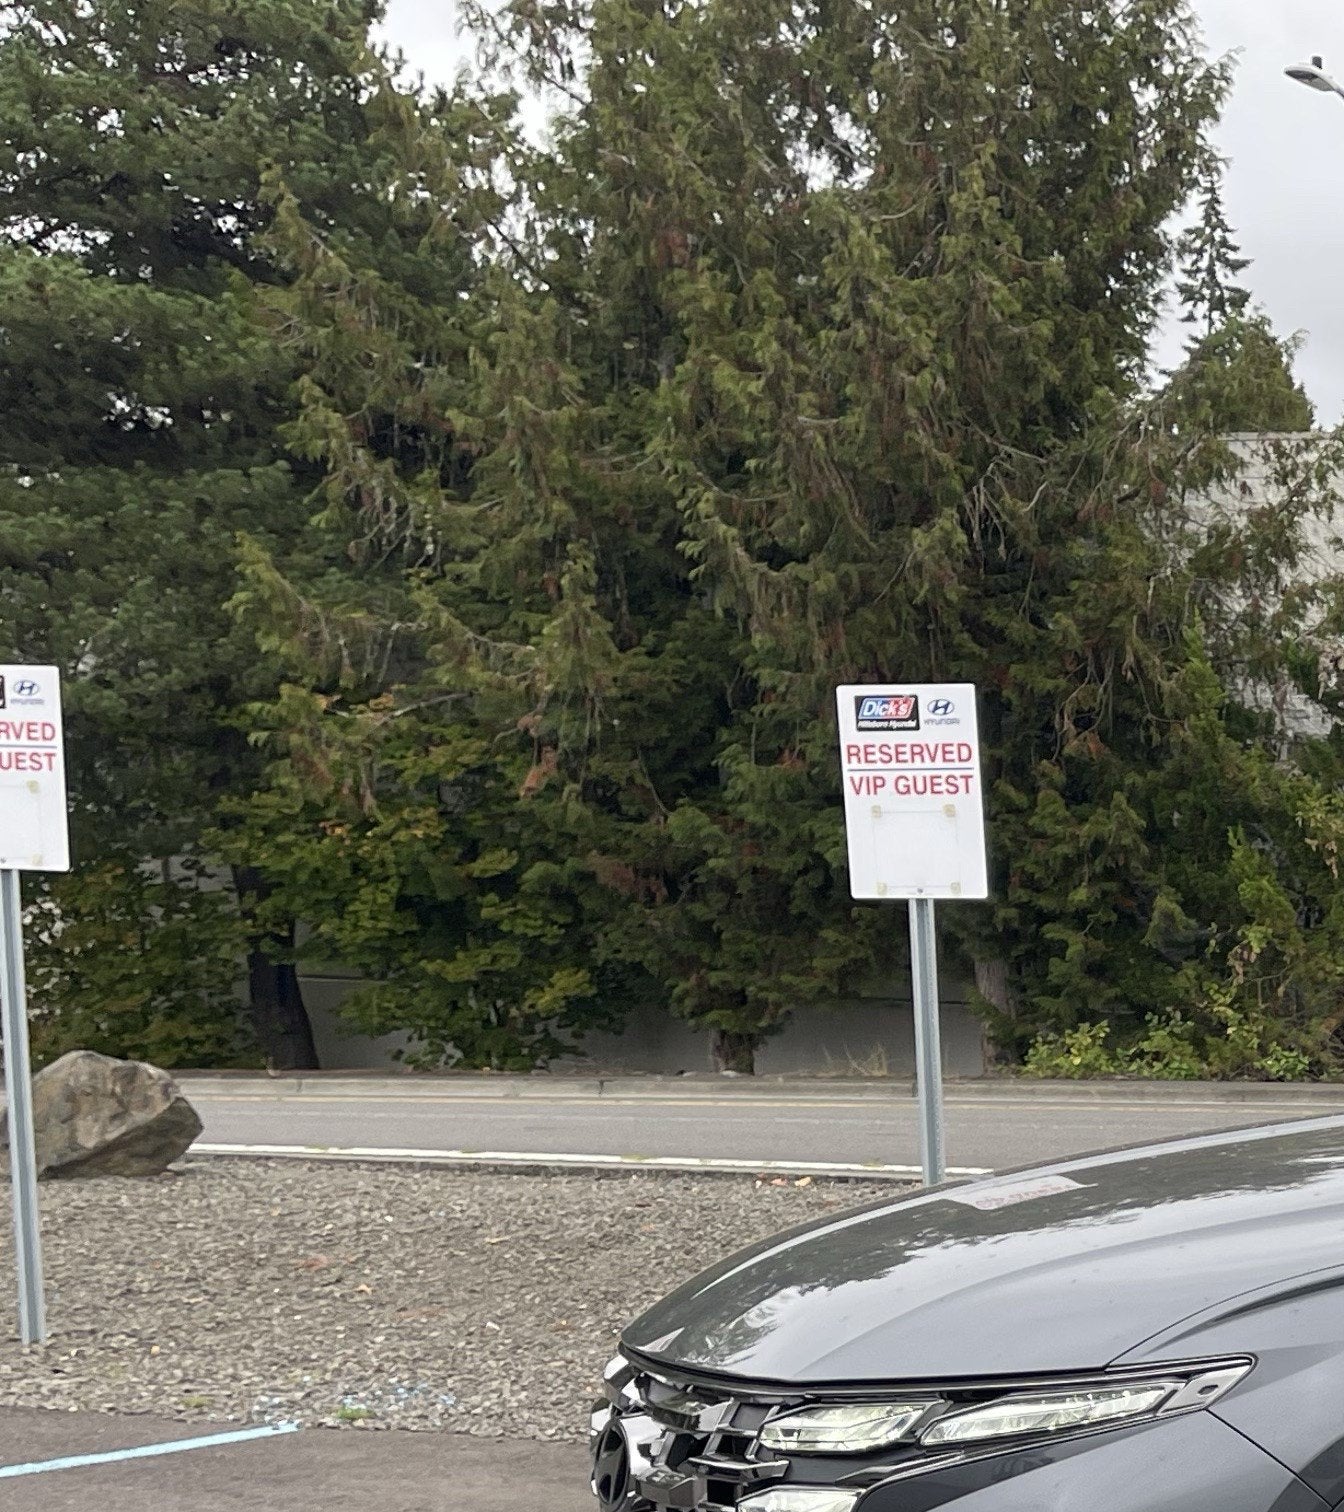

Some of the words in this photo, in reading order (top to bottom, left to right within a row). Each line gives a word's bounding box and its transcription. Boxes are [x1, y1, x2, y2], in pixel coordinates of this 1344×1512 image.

[846, 742, 973, 765] RESERVED
[850, 775, 886, 796] VIP
[894, 774, 973, 796] GUEST
